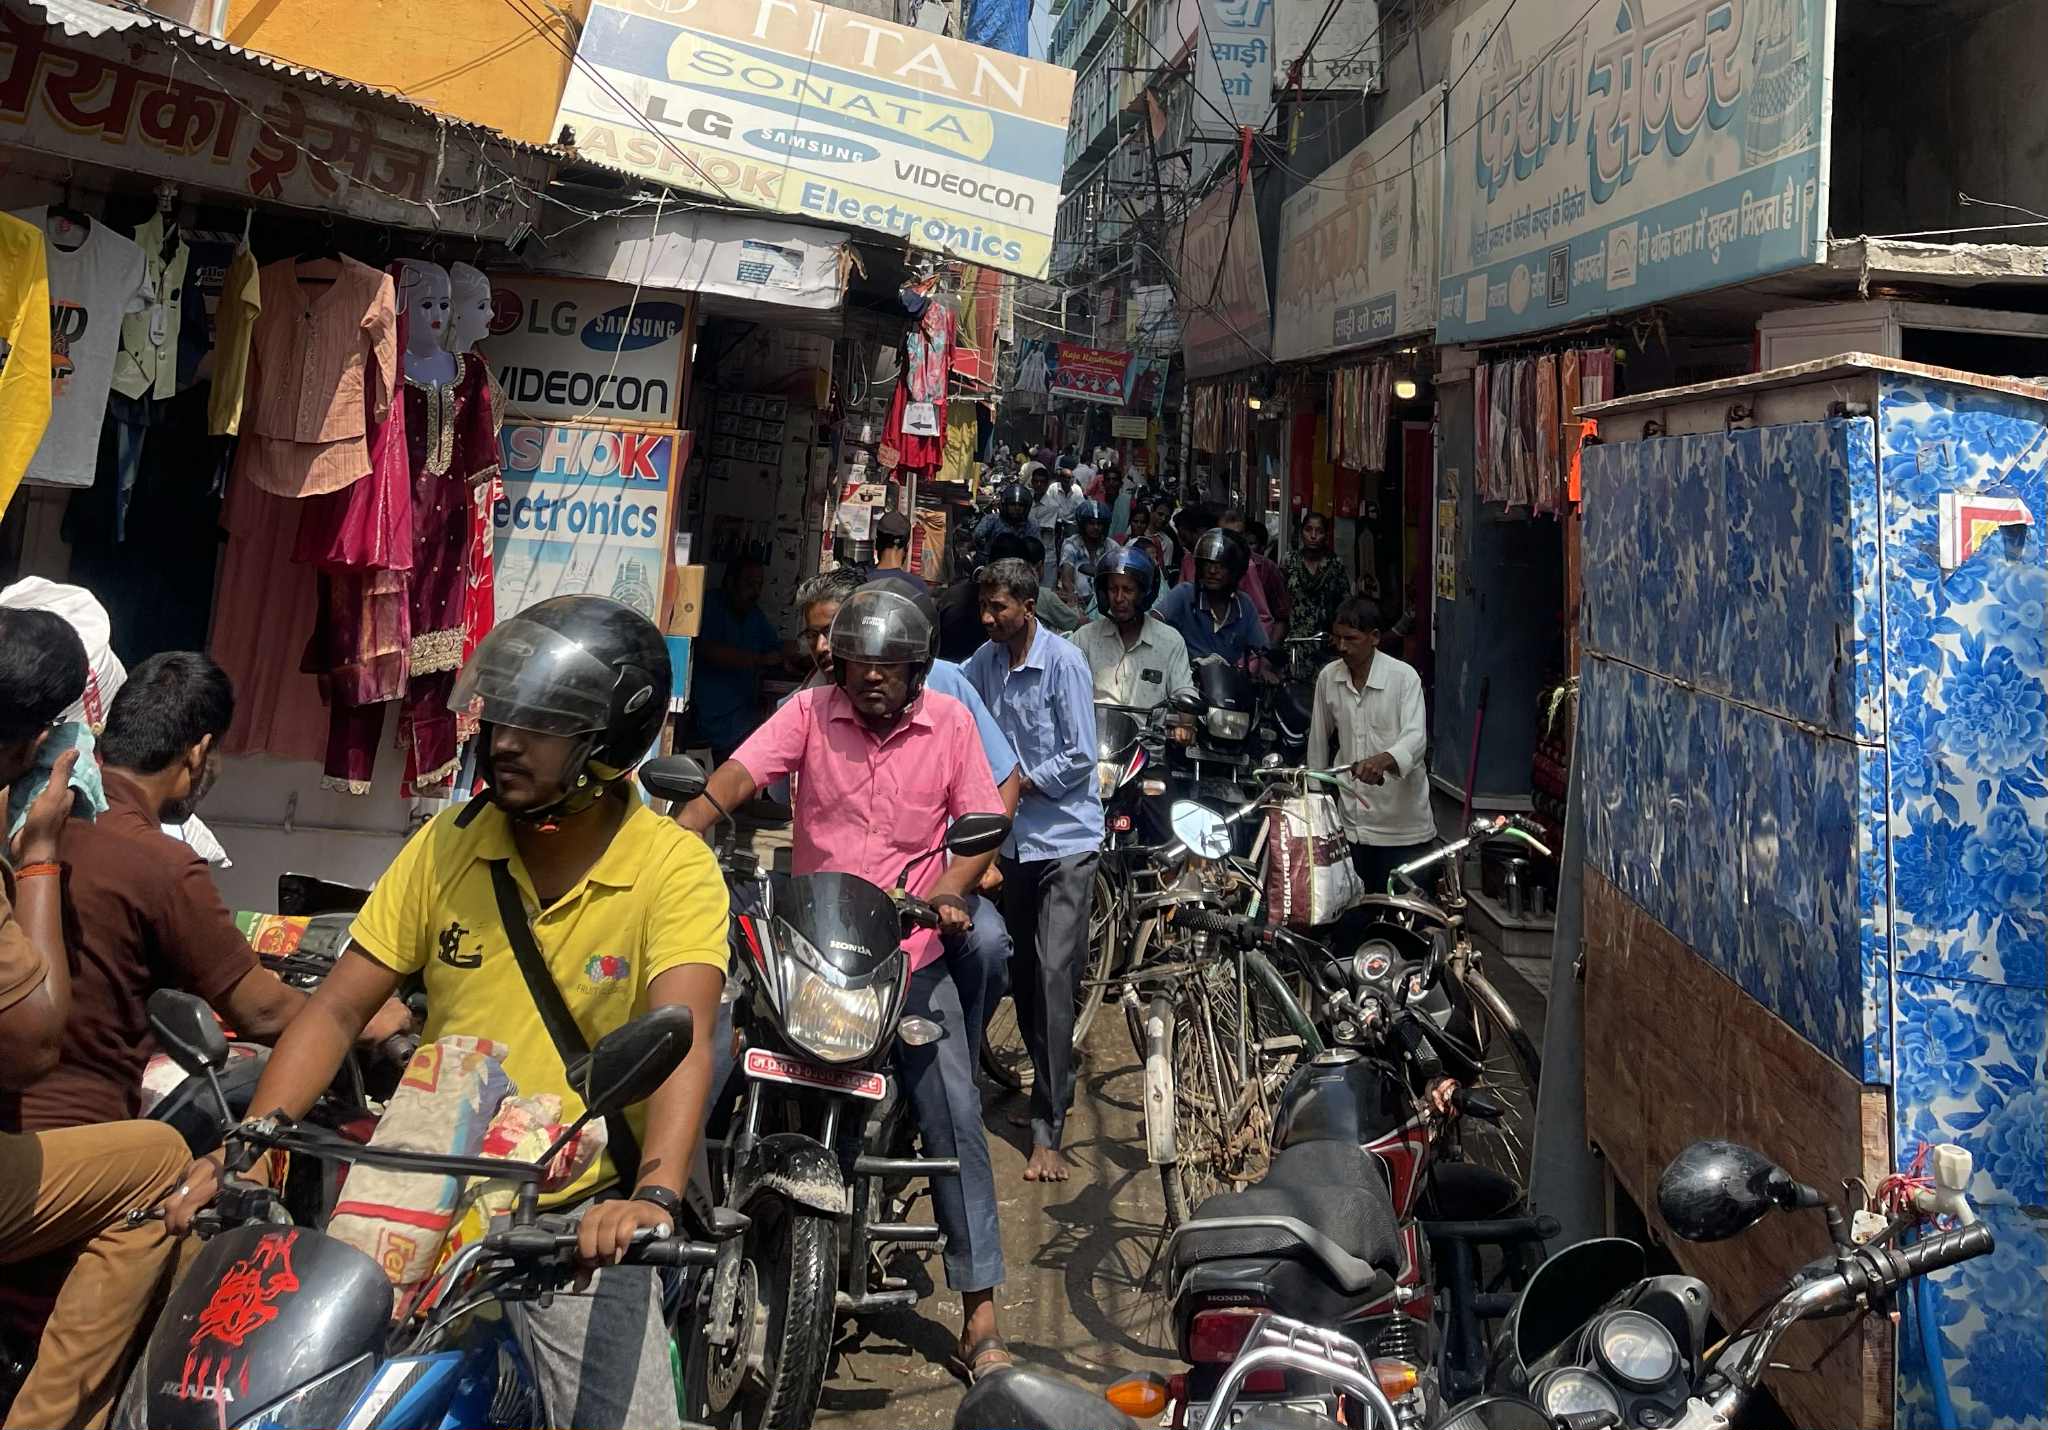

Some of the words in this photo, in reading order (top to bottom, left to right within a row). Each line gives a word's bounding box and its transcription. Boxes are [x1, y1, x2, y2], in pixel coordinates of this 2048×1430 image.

[752, 0, 1030, 108] TITAN
[645, 96, 735, 141] LG
[688, 49, 973, 144] SONATA
[579, 127, 785, 200] ASHOK
[760, 127, 866, 163] SAMSUNG
[893, 159, 1035, 215] VIDEOCON
[799, 183, 1023, 264] Electronics
[1708, 208, 1739, 264] खुदरा
[1740, 189, 1780, 239] मिलता
[527, 301, 577, 336] LG
[594, 315, 677, 339] SAMSUNG
[501, 428, 661, 479] SHOK
[494, 490, 658, 539] ectronics
[829, 940, 872, 957] HONDA
